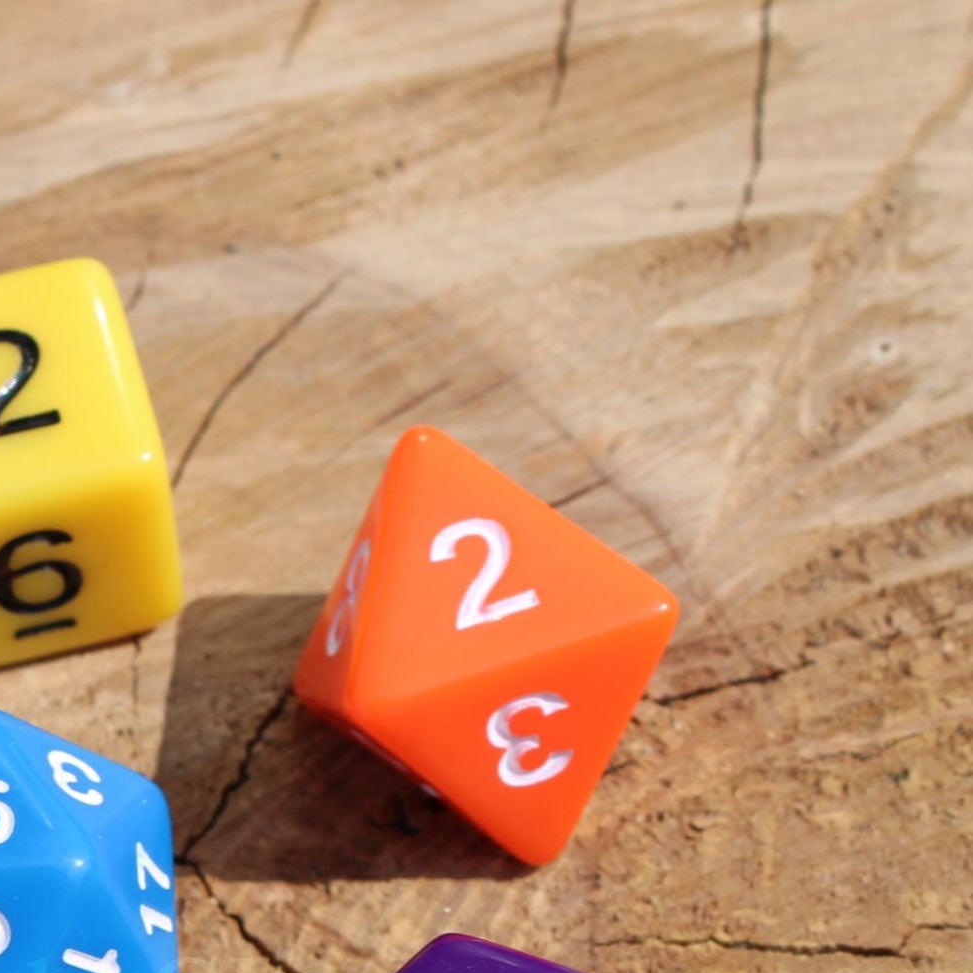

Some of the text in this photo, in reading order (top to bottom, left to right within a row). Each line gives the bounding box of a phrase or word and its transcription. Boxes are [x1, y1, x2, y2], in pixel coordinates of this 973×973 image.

[429, 518, 541, 630] 2
[47, 750, 104, 806] 3
[485, 691, 574, 787] 3
